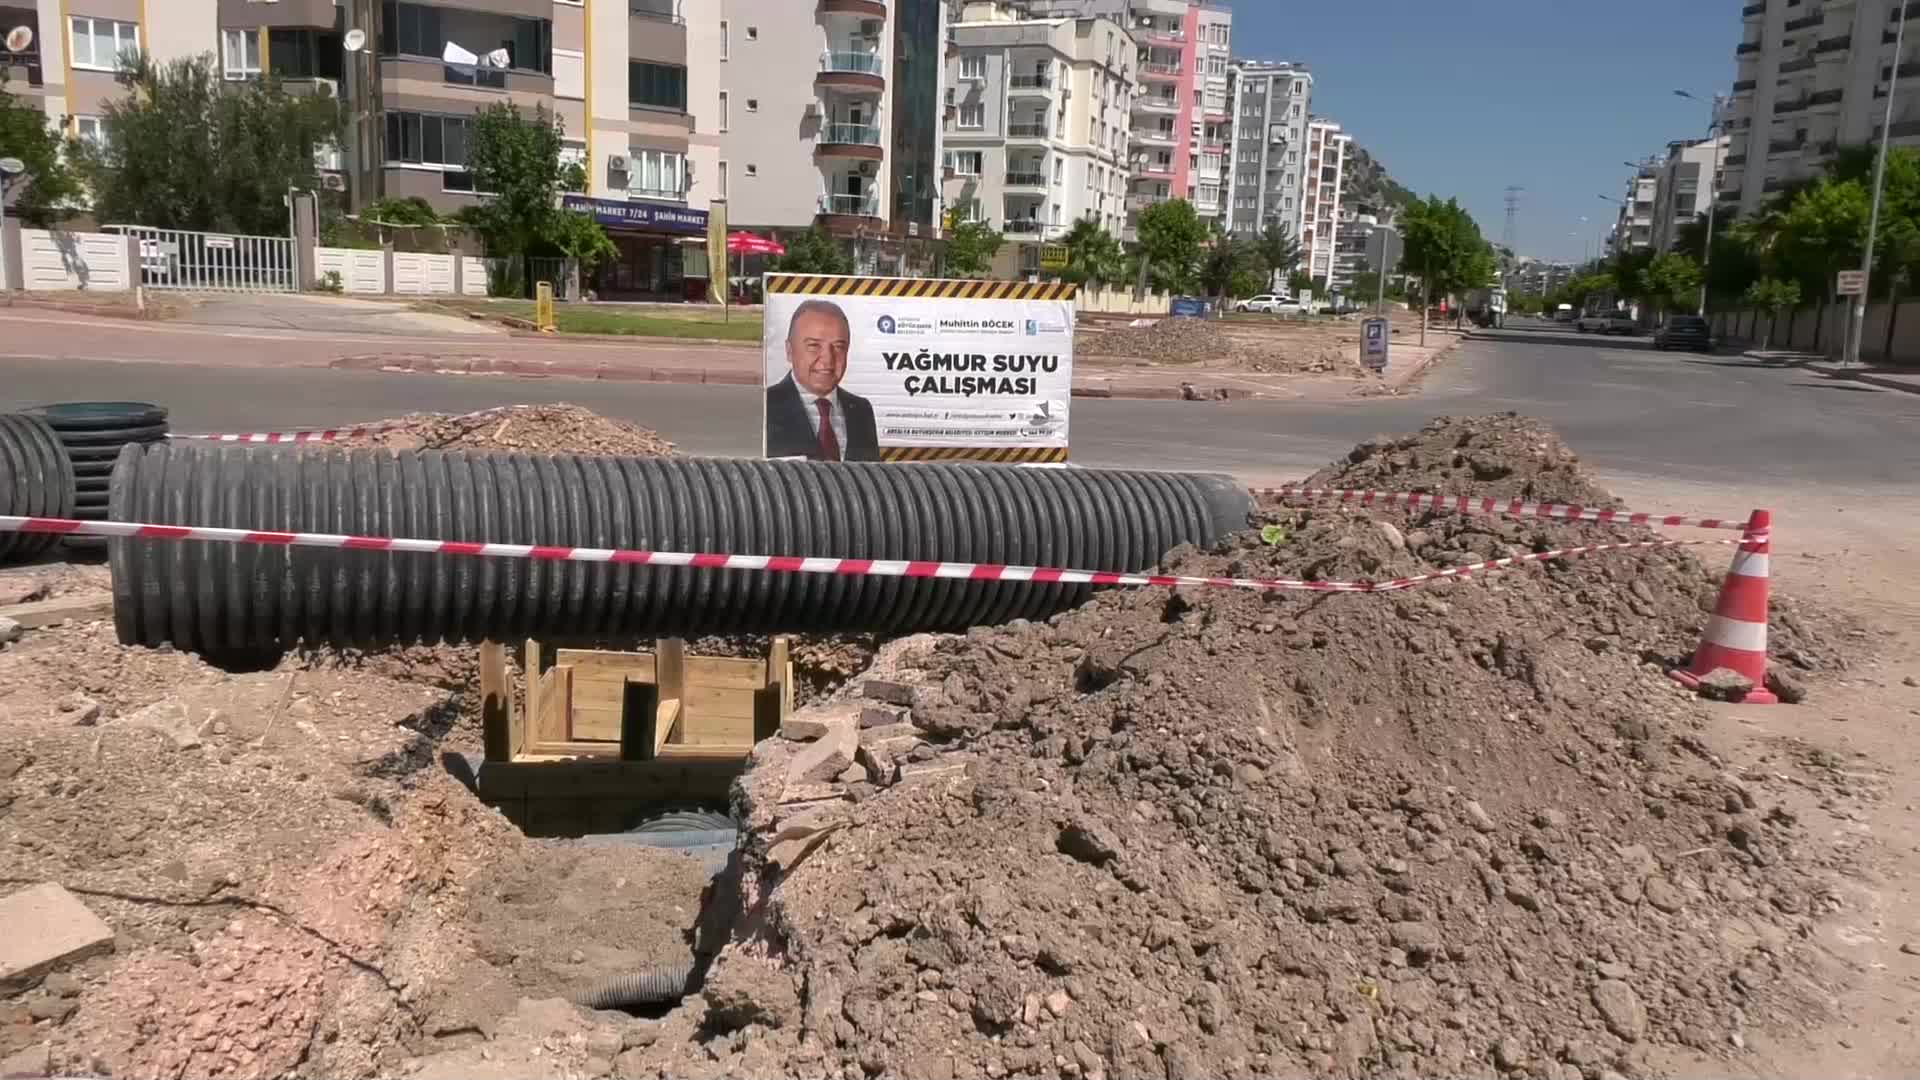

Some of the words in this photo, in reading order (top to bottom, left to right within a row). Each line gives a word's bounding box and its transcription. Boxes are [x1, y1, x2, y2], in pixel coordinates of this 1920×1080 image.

[596, 207, 626, 216] MARKET
[629, 208, 648, 219] 7/24
[654, 209, 676, 222] ŞAHİN
[677, 213, 705, 225] MARKET
[939, 319, 980, 328] Muhittin
[982, 319, 1015, 329] BÖCEK
[882, 349, 986, 372] YAĞMUR
[993, 354, 1058, 373] SUYU
[904, 375, 1037, 397] ÇALIŞMASI
